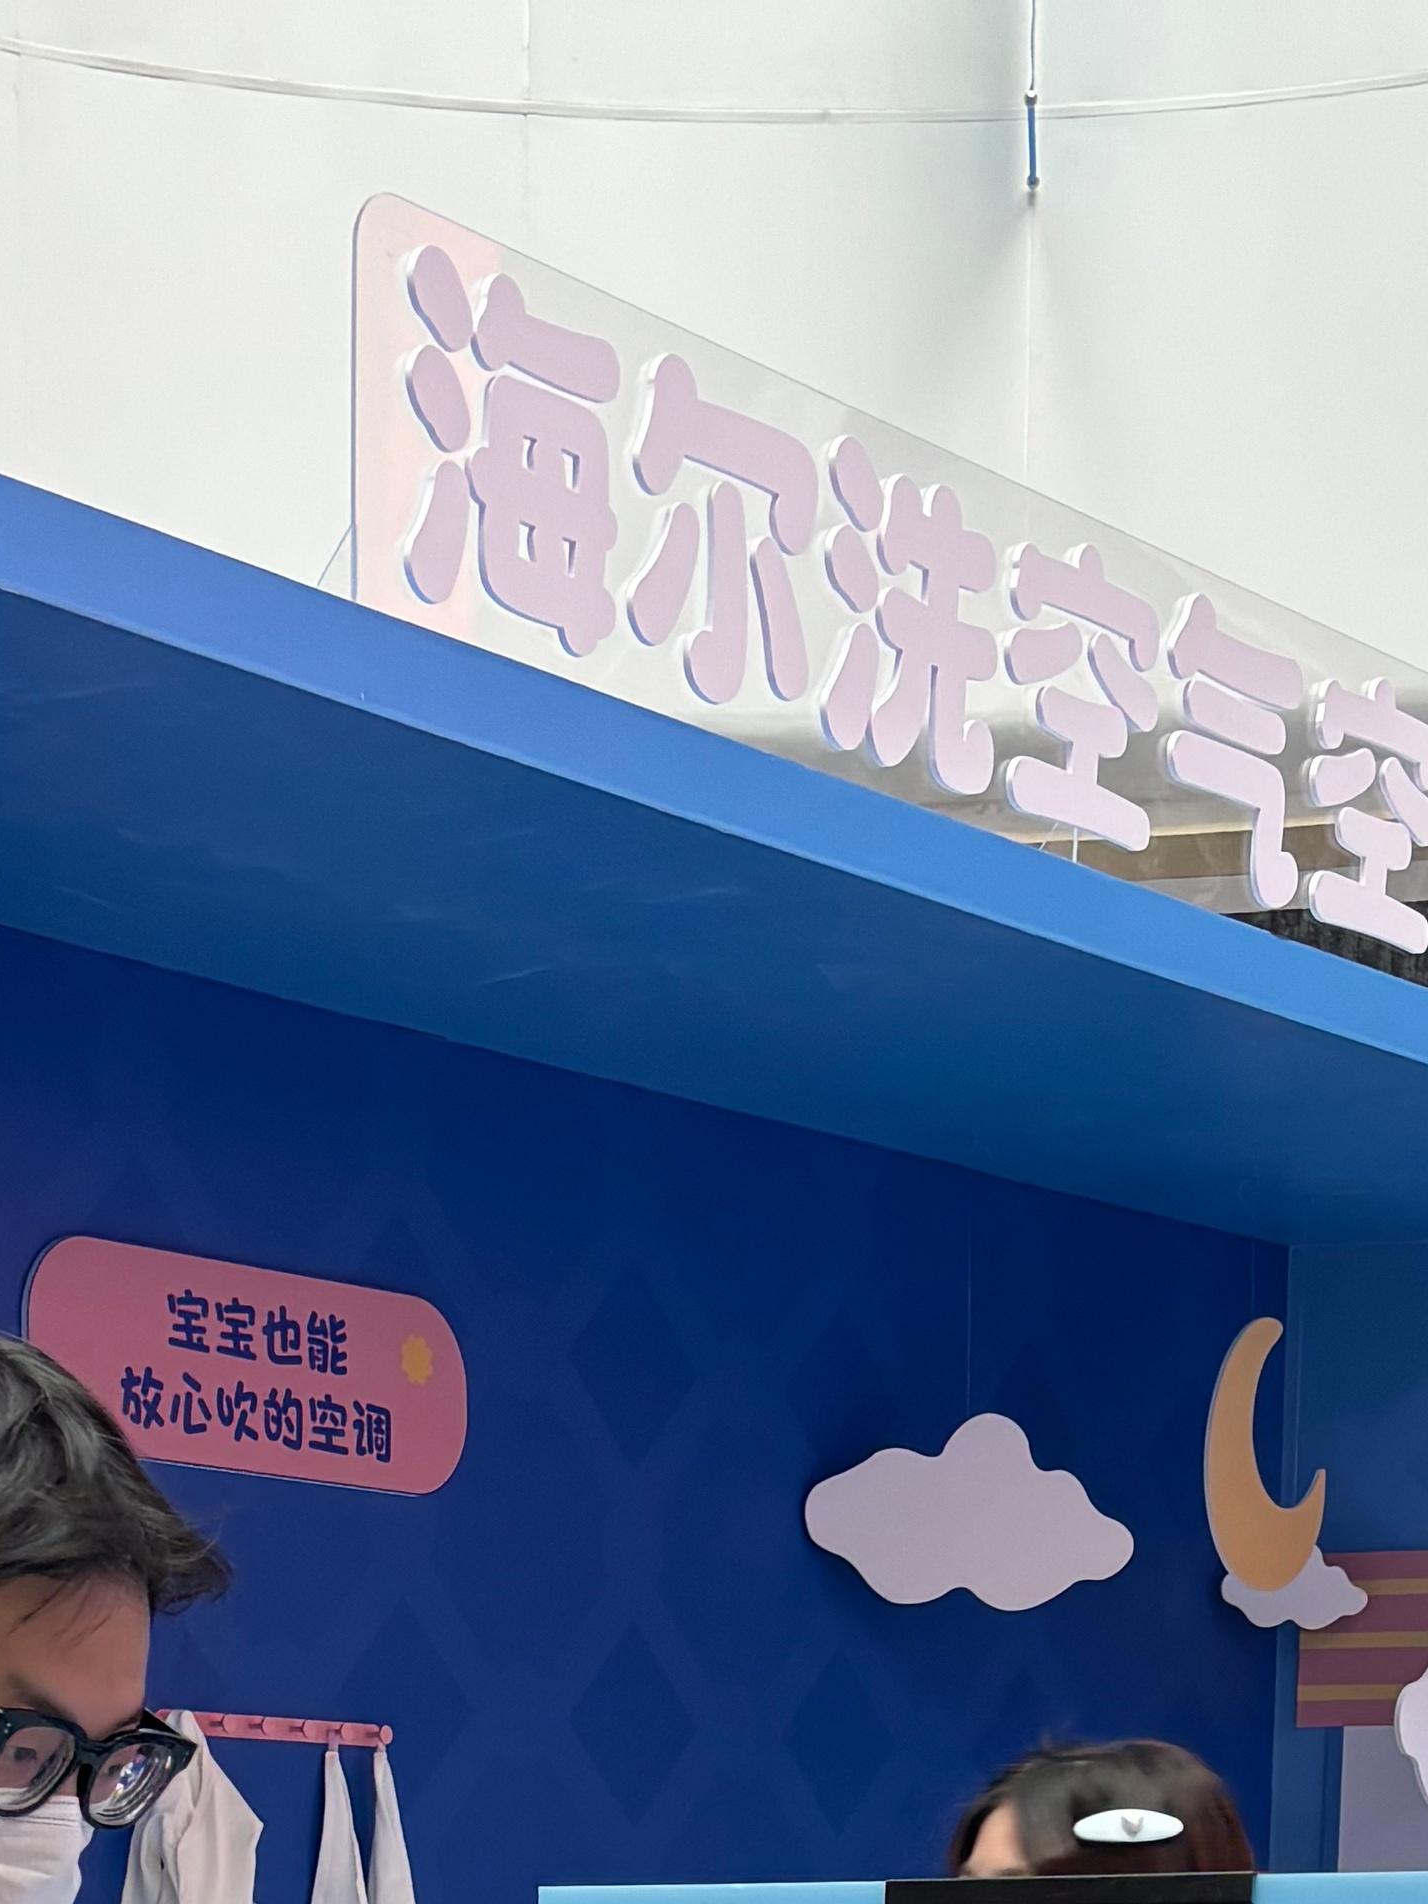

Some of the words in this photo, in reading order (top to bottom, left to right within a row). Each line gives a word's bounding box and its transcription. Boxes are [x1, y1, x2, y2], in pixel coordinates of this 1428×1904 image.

[167, 1289, 348, 1376] 宝宝也能
[120, 1366, 392, 1463] 放心吹的空调
